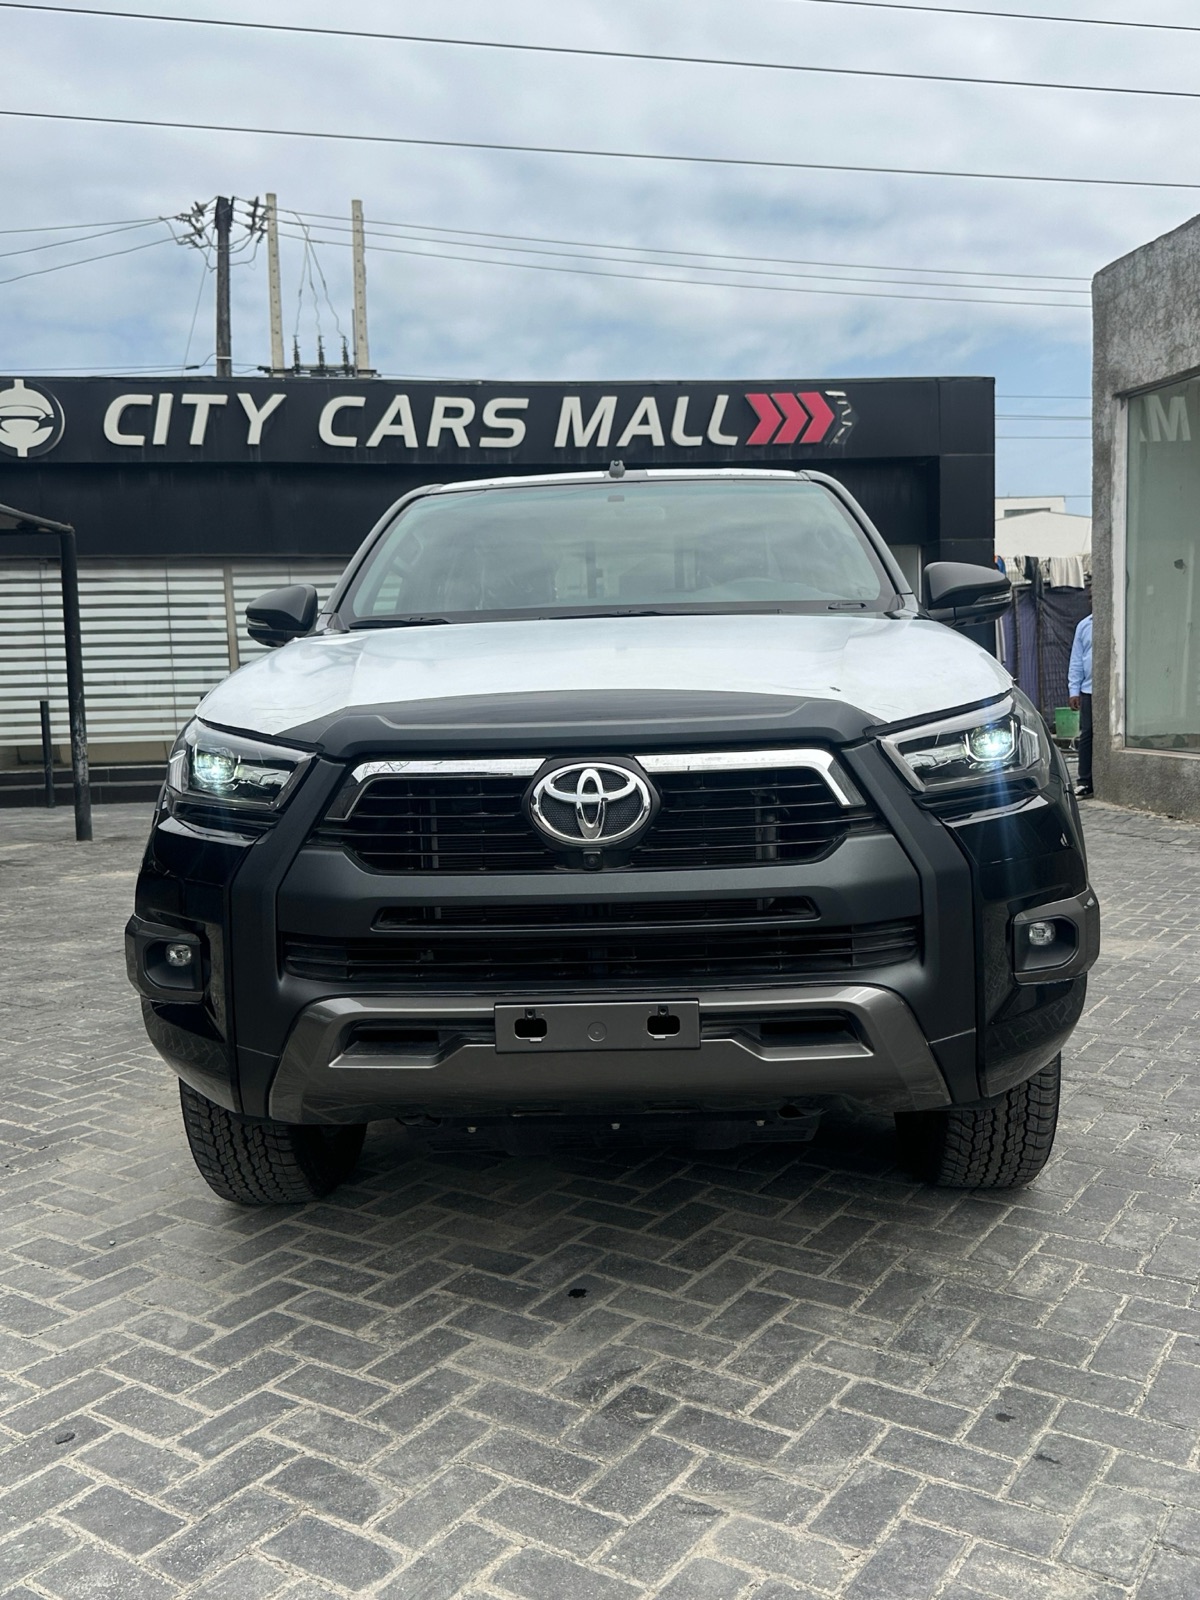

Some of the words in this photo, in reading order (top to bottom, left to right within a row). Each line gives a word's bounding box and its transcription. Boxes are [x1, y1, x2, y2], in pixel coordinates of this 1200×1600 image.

[103, 392, 287, 446] CITY
[318, 394, 530, 448] CARS
[554, 394, 739, 448] MALL
